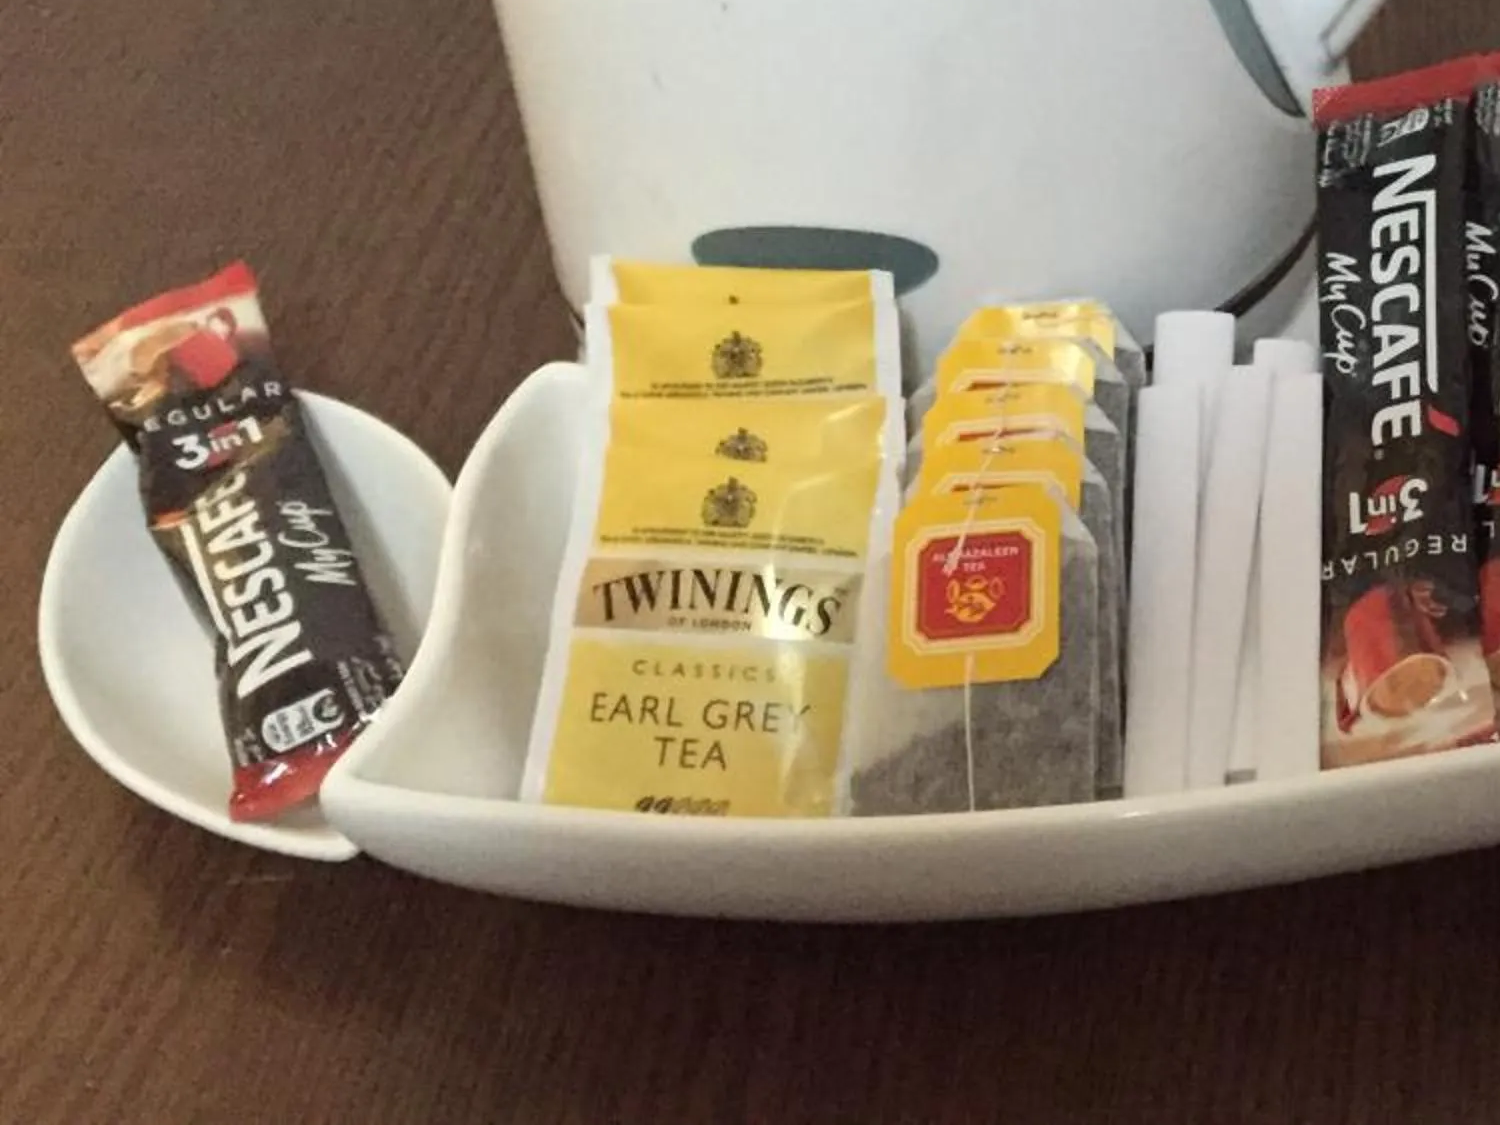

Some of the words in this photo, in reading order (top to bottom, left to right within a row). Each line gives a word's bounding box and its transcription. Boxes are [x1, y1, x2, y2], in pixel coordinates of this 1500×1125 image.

[1319, 252, 1358, 303] My
[1321, 302, 1367, 375] Cup
[143, 380, 282, 433] EGULAR
[277, 500, 335, 548] Cup
[294, 548, 357, 586] My
[1320, 533, 1468, 582] REGULAR
[592, 568, 843, 637] TWININGS
[692, 617, 753, 631] LONDON
[631, 658, 777, 683] CLASSICS
[590, 691, 684, 728] EARL
[701, 697, 813, 734] GREY
[653, 735, 728, 772] TEA
